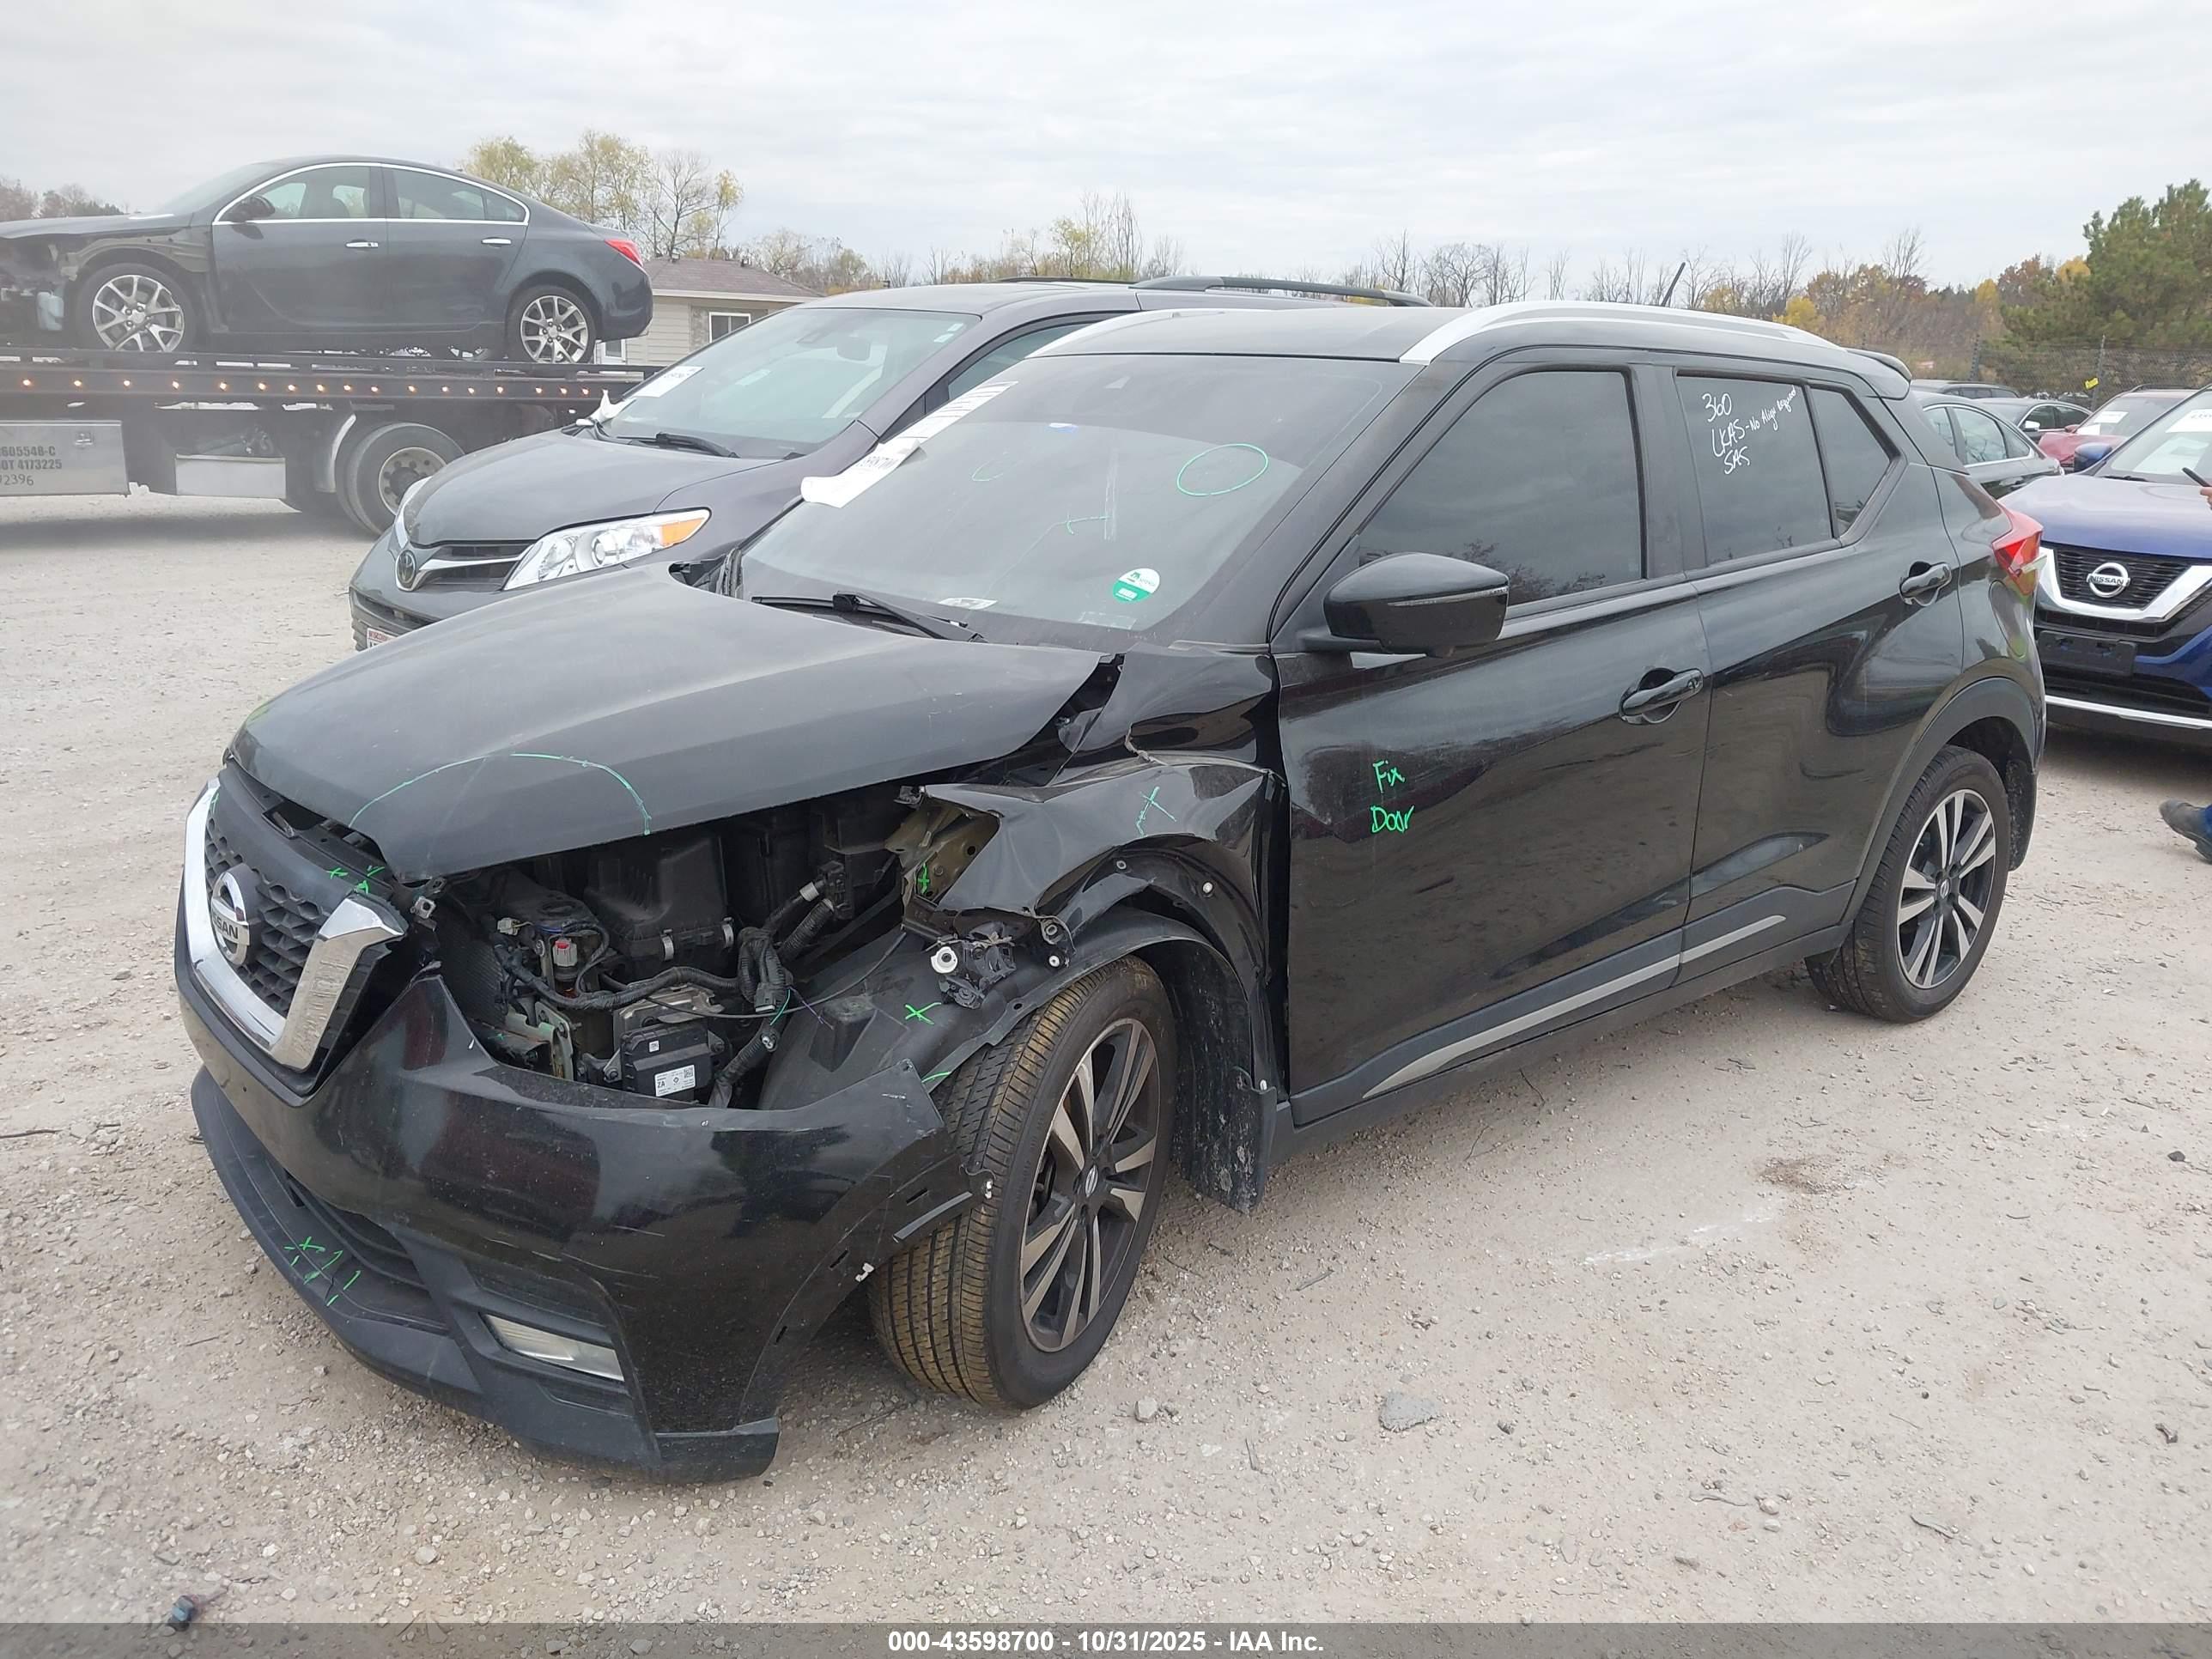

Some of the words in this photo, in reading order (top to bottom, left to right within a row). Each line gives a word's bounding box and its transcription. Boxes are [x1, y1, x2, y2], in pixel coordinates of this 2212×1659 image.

[1702, 392, 1732, 422] 360
[0, 446, 56, 457] 605548-C
[1723, 446, 1750, 475] SAS
[0, 459, 15, 471] OT
[17, 459, 63, 470] 4173225
[2089, 575, 2124, 585] NISSAN
[1372, 760, 1406, 794] Fix
[212, 910, 239, 939] SSAN
[657, 1080, 665, 1089] ZA
